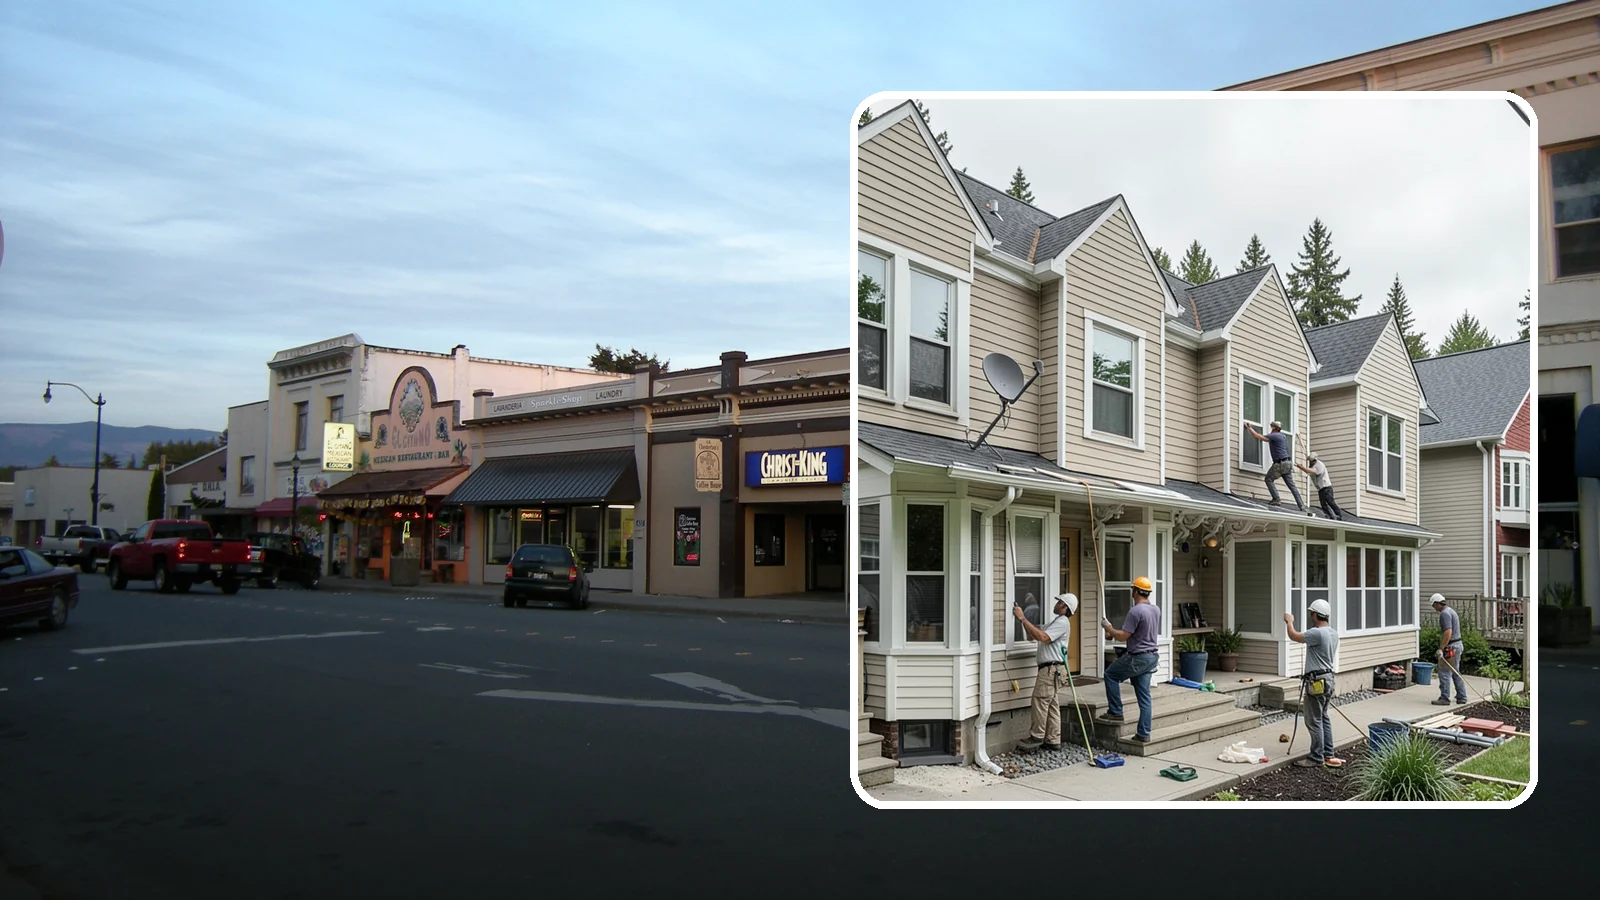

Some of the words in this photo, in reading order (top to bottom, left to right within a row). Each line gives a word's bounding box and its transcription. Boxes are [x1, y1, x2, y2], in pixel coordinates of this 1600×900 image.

[560, 394, 583, 406] Shop
[595, 389, 623, 400] LAUNDRY
[374, 455, 396, 464] MEXICAN
[398, 451, 433, 462] RESTAURANT
[438, 450, 450, 459] BAR
[760, 452, 798, 478] CHRIST
[798, 450, 828, 477] KING
